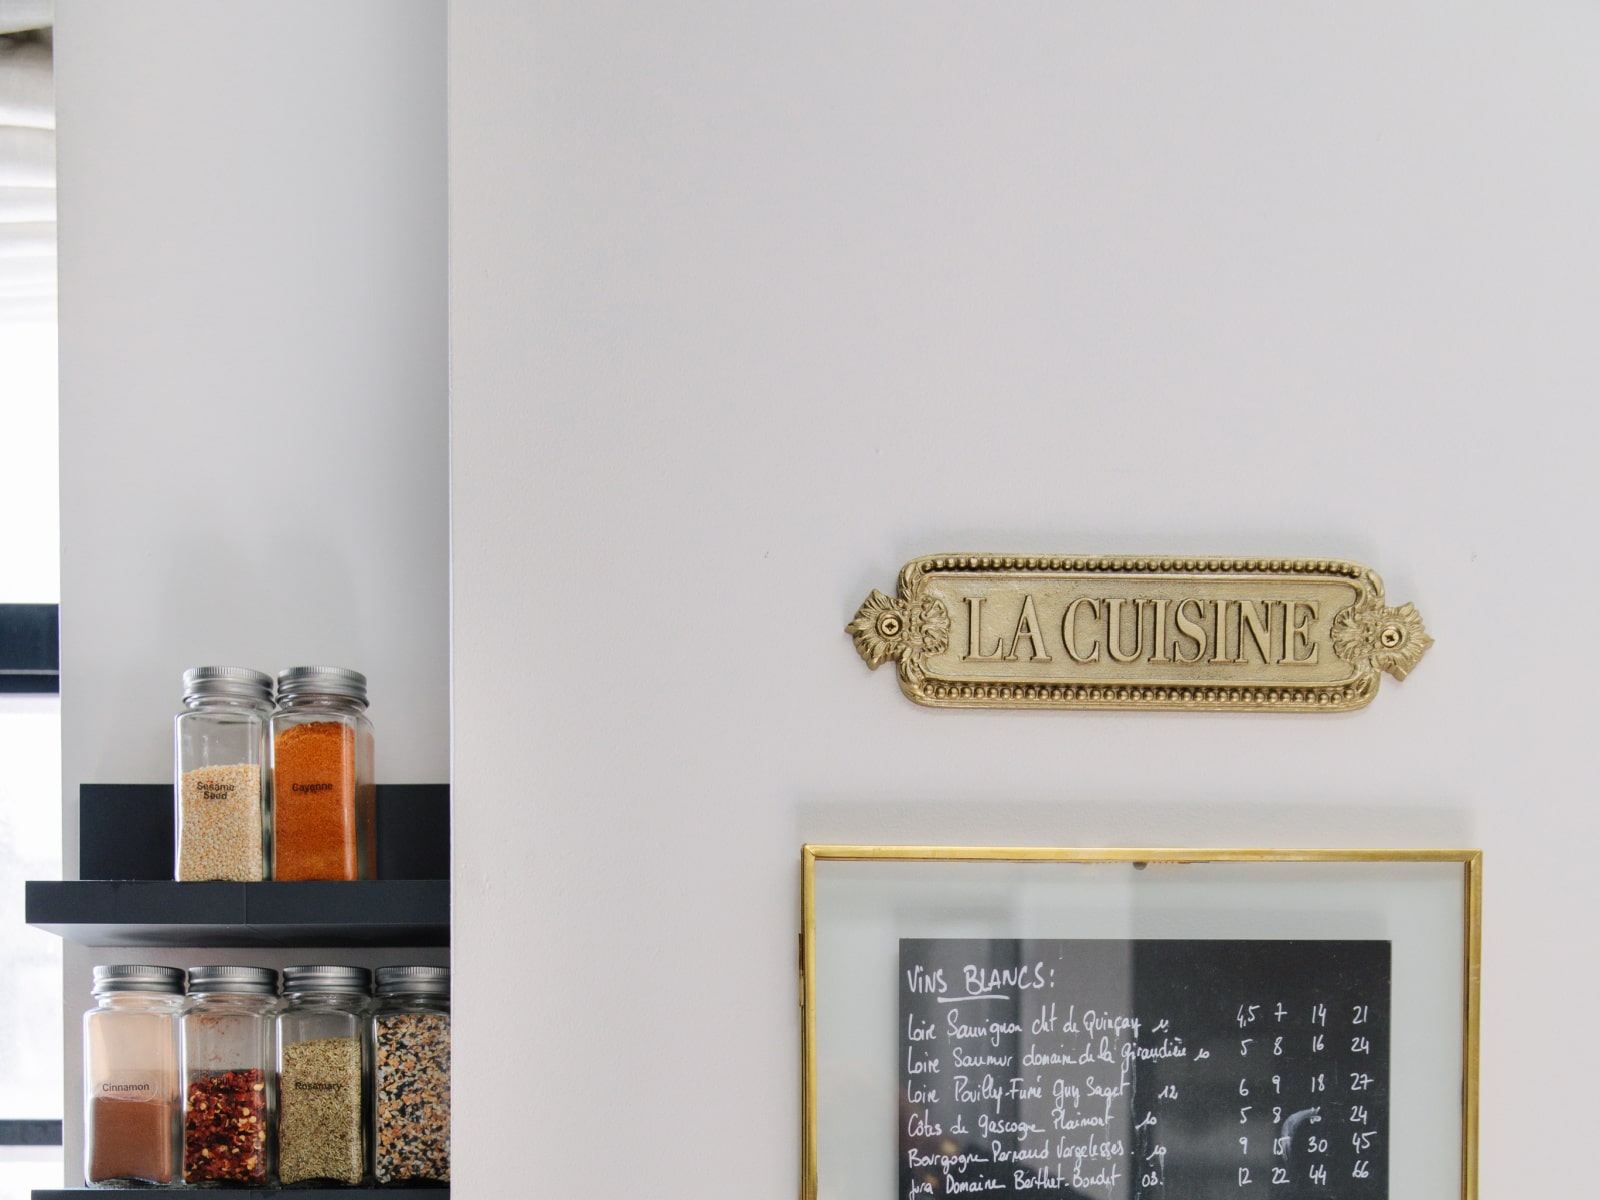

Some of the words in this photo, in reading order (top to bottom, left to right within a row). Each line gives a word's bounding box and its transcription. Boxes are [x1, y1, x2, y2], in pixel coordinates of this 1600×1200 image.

[962, 595, 1051, 663] LA
[1062, 596, 1320, 665] CUISINE
[197, 781, 235, 792] Sesame
[203, 790, 228, 800] Seed
[291, 782, 333, 794] Cayenne
[963, 962, 1055, 995] BLANCS:
[908, 1013, 936, 1041] Loire
[947, 1008, 1023, 1047] Sauvignon
[1063, 1005, 1080, 1033] de
[1274, 1002, 1288, 1022] 7
[1312, 1003, 1327, 1027] 14
[1352, 1005, 1368, 1024] 21
[1241, 1039, 1253, 1055] 5
[1273, 1036, 1283, 1055] 8
[1312, 1034, 1324, 1052] 16
[1350, 1037, 1369, 1054] 24
[908, 1045, 940, 1074] Loire
[953, 1047, 1013, 1068] Saumur
[102, 1083, 150, 1092] Cinnamon
[295, 1081, 342, 1092] Rosemary
[908, 1080, 940, 1103] Loire
[1158, 1085, 1178, 1099] 12
[1239, 1079, 1249, 1096] 6
[1272, 1075, 1280, 1094] 9
[1312, 1074, 1325, 1093] 18
[1350, 1073, 1374, 1090] 27
[950, 1114, 968, 1134] de
[1240, 1106, 1252, 1124] 5
[1273, 1106, 1281, 1124] 8
[1350, 1105, 1368, 1124] 24
[1239, 1137, 1248, 1154] 9
[1274, 1136, 1290, 1155] 15
[1307, 1136, 1328, 1152] 30
[1352, 1131, 1377, 1153] 45
[908, 1148, 988, 1175] Bourgogne
[1239, 1167, 1252, 1186] 12
[1272, 1167, 1290, 1184] 22
[1309, 1164, 1327, 1185] 44
[1352, 1160, 1369, 1178] 66
[946, 1174, 1006, 1195] Domaine
